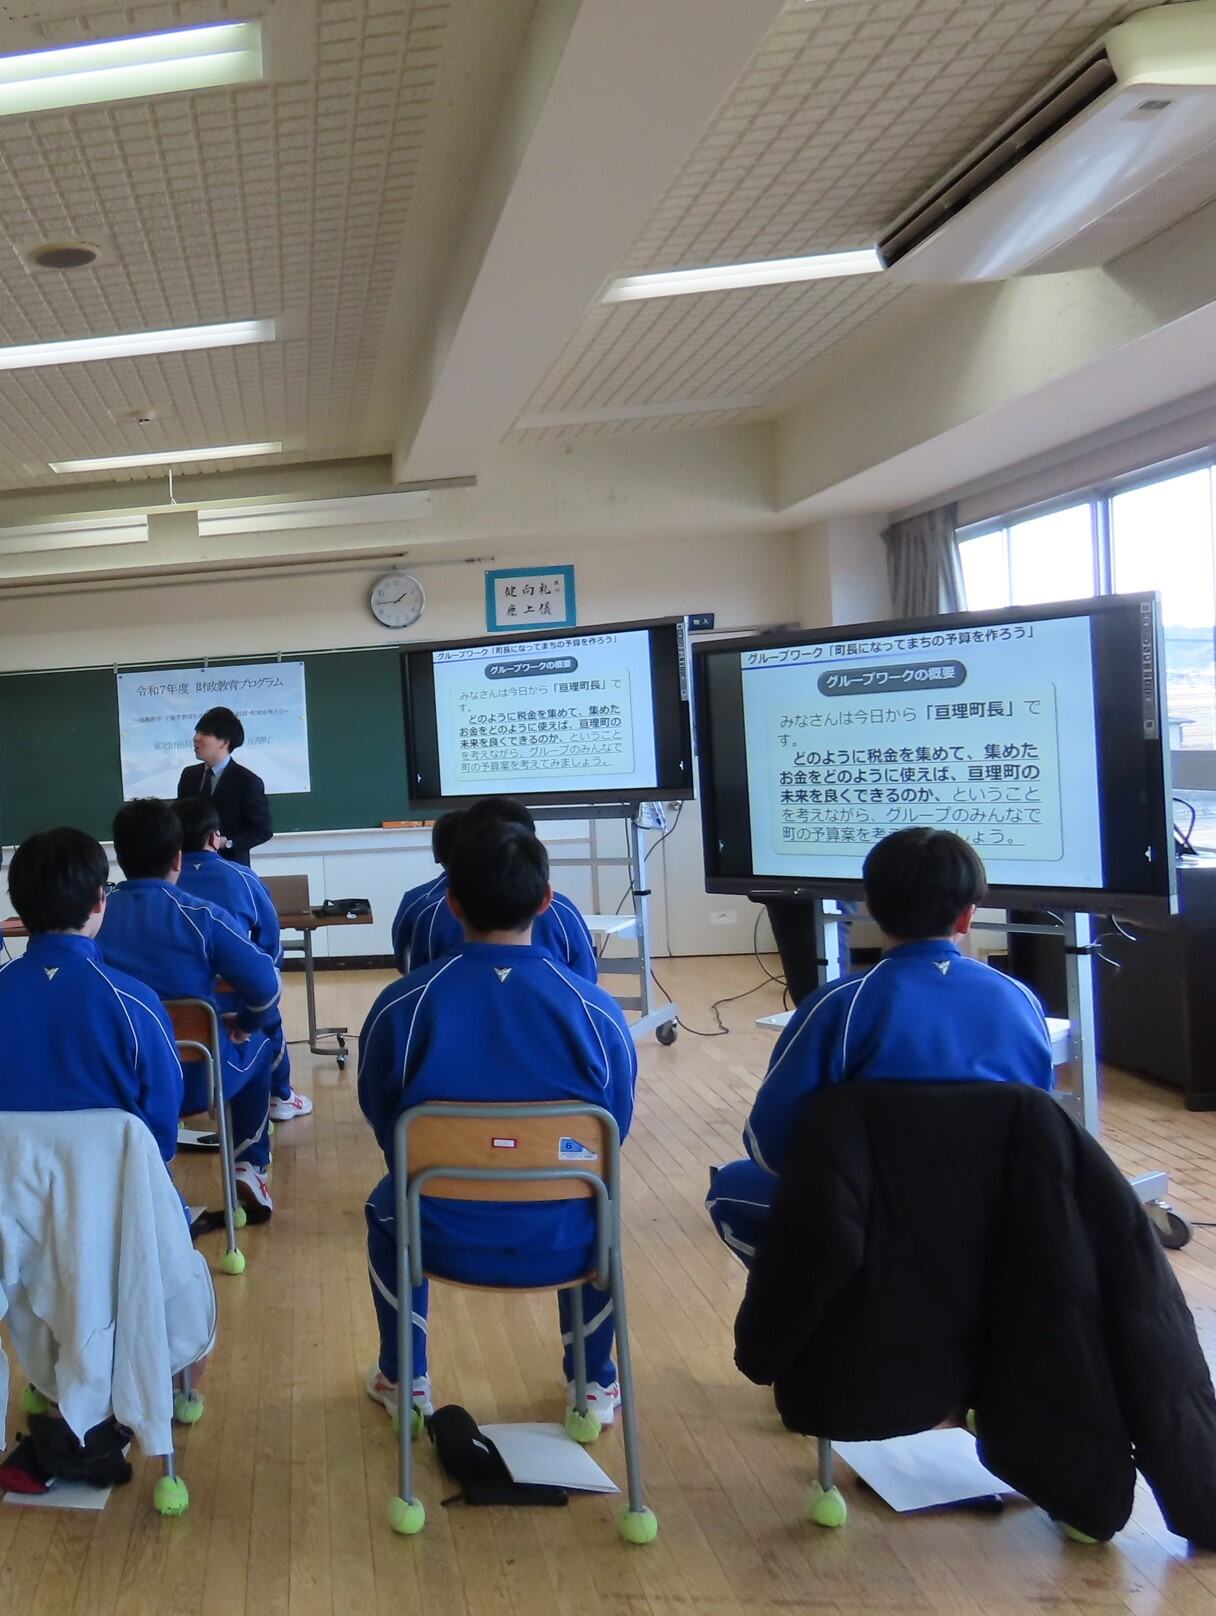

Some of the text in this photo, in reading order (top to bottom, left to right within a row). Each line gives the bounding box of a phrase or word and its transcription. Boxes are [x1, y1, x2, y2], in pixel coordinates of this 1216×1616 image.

[504, 584, 518, 617] 健康
[522, 583, 536, 614] 向上
[538, 582, 552, 616] 礼儀
[746, 626, 1035, 666] グループワーク「町長になってまちの予算を作ろう」
[136, 677, 284, 697] 令和7年度 財政教育プログラム
[825, 666, 956, 690] グループワークの概要
[468, 704, 621, 724] どのように税金を集めて、集めた
[779, 699, 1042, 729] みなさんは今日から「亘理町長」で
[459, 717, 622, 737] お金をどのように使えば、亘理町の
[778, 732, 799, 748] す。
[792, 742, 1040, 766] どのように税金を集めて、集めた
[779, 763, 1041, 785] お金をどのように使えば、亘理町の
[779, 786, 1042, 805] 未来を良くできるのか、ということ
[781, 806, 1043, 824] を考えながら、グループのみんなで
[565, 1141, 573, 1150] 6
